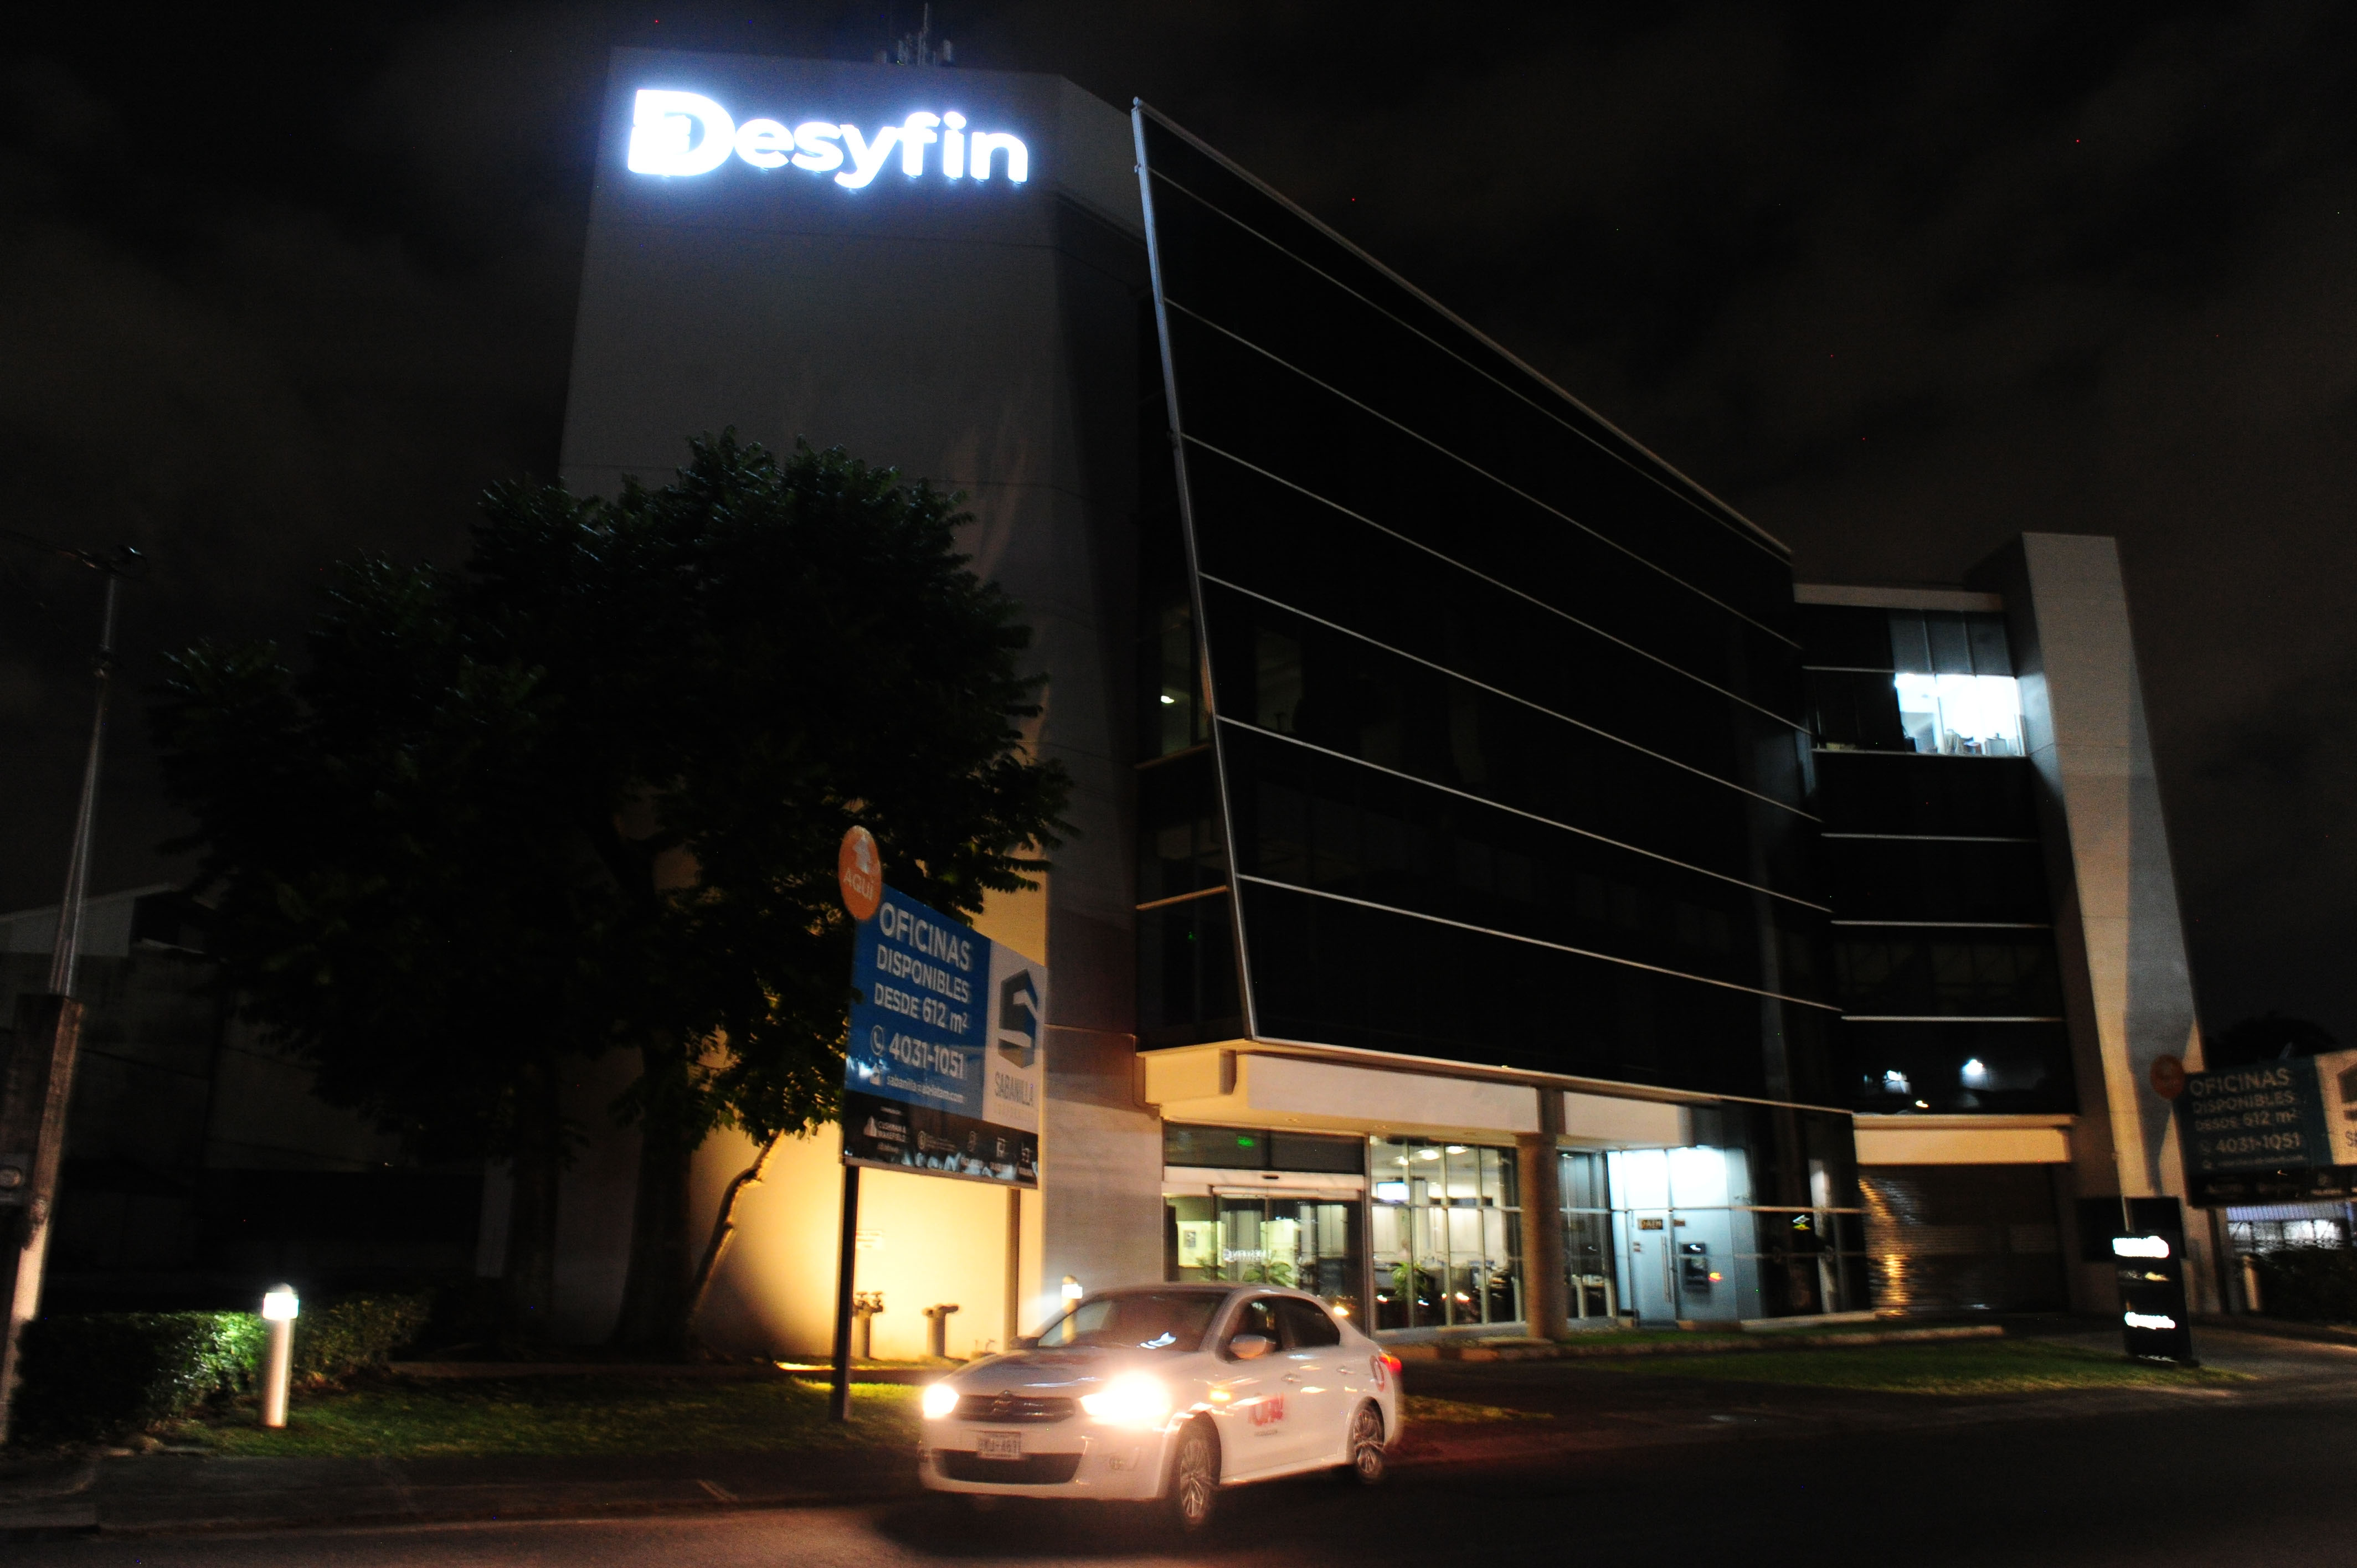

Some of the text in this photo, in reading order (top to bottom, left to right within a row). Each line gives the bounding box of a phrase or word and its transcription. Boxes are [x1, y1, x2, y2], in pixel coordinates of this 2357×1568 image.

[628, 89, 1028, 189] Desyfin
[879, 902, 972, 972] OFICINAS
[877, 943, 970, 1004] DISPONIBLES
[874, 982, 920, 1019] DESDE
[923, 997, 947, 1028] 612
[889, 1032, 965, 1079] 4031-1051
[2190, 1067, 2291, 1097] OFICINAS
[2193, 1090, 2296, 1115] DISPONIBLES
[2243, 1110, 2271, 1127] 612
[2216, 1132, 2301, 1153] 4031-1051
